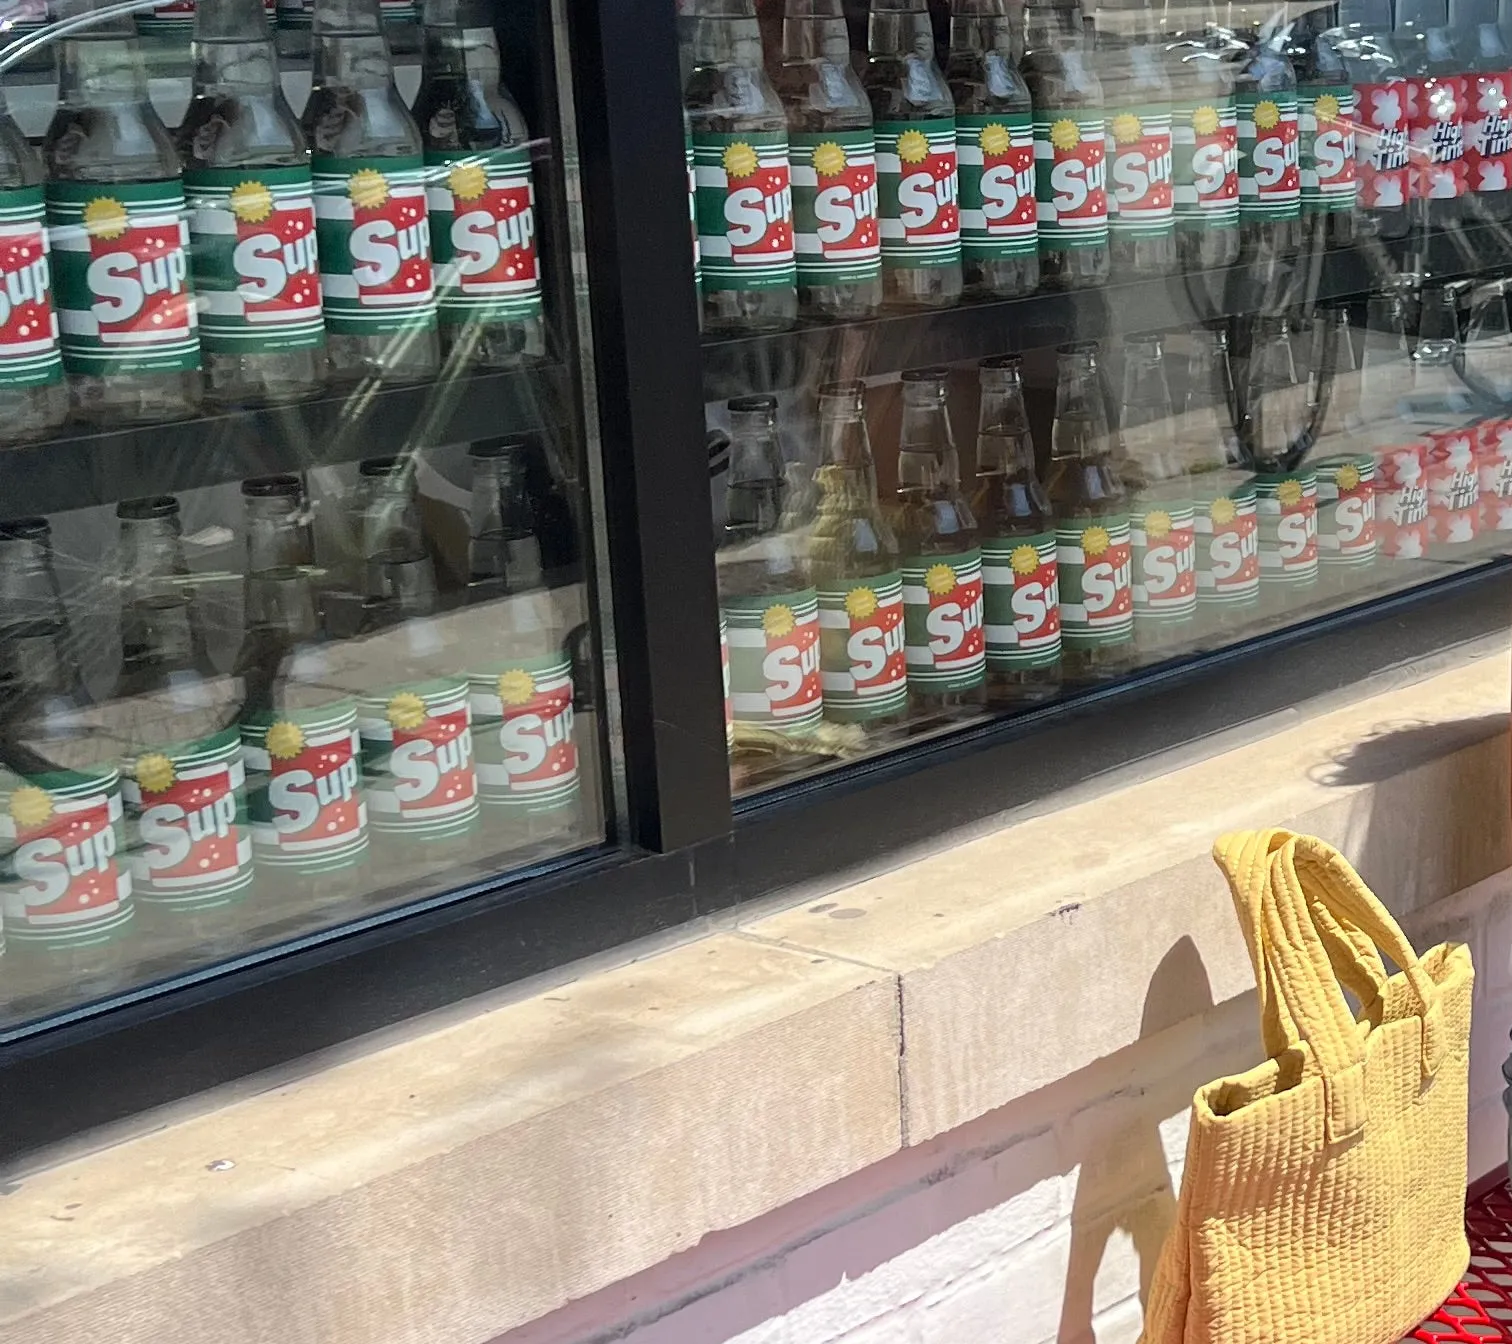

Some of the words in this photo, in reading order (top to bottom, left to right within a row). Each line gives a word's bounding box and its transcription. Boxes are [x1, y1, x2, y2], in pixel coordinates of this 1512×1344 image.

[1112, 145, 1172, 204] Sup
[1313, 130, 1355, 178] Su
[450, 204, 535, 275] Sup
[724, 183, 792, 247] Sup
[814, 182, 879, 243] Sup
[88, 246, 187, 323] Sup
[233, 227, 318, 302] Sup
[350, 214, 430, 287] Sup
[0, 254, 49, 331] up
[390, 725, 473, 801] Sup
[500, 701, 574, 775] Sup
[140, 788, 236, 870] Sup
[269, 755, 358, 833] Sup
[15, 825, 116, 906] Sup
